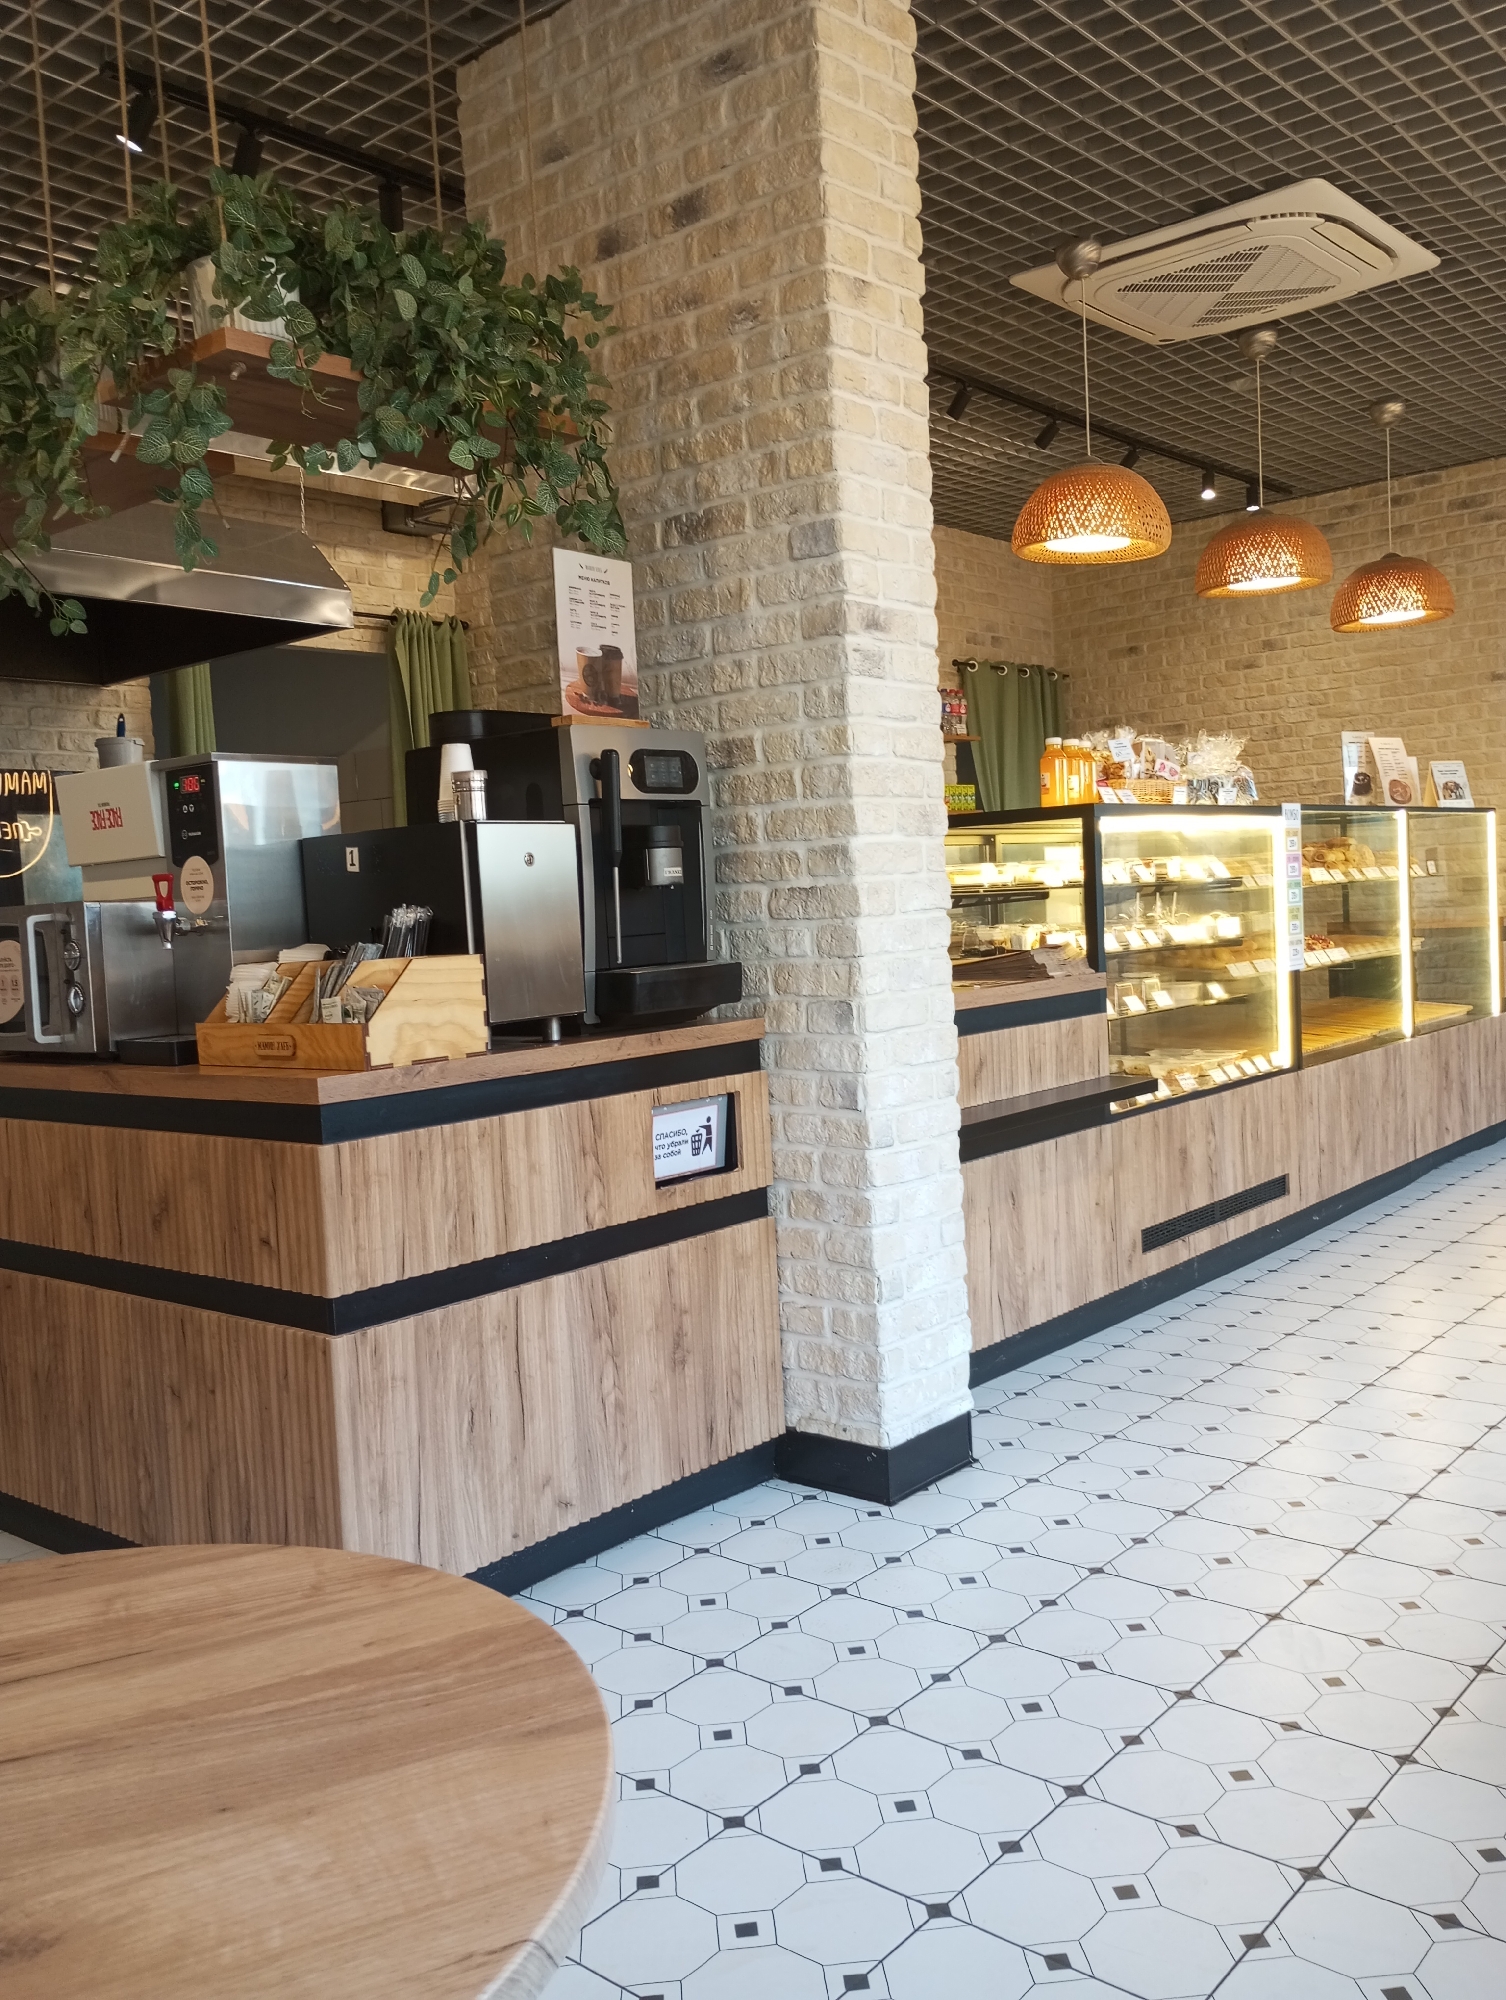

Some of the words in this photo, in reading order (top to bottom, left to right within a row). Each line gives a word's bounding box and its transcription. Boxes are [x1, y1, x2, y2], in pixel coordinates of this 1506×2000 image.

[349, 850, 356, 866] 1
[655, 1128, 688, 1141] СПАСИБО,
[667, 1139, 689, 1150] убрали
[662, 1149, 682, 1159] собой
